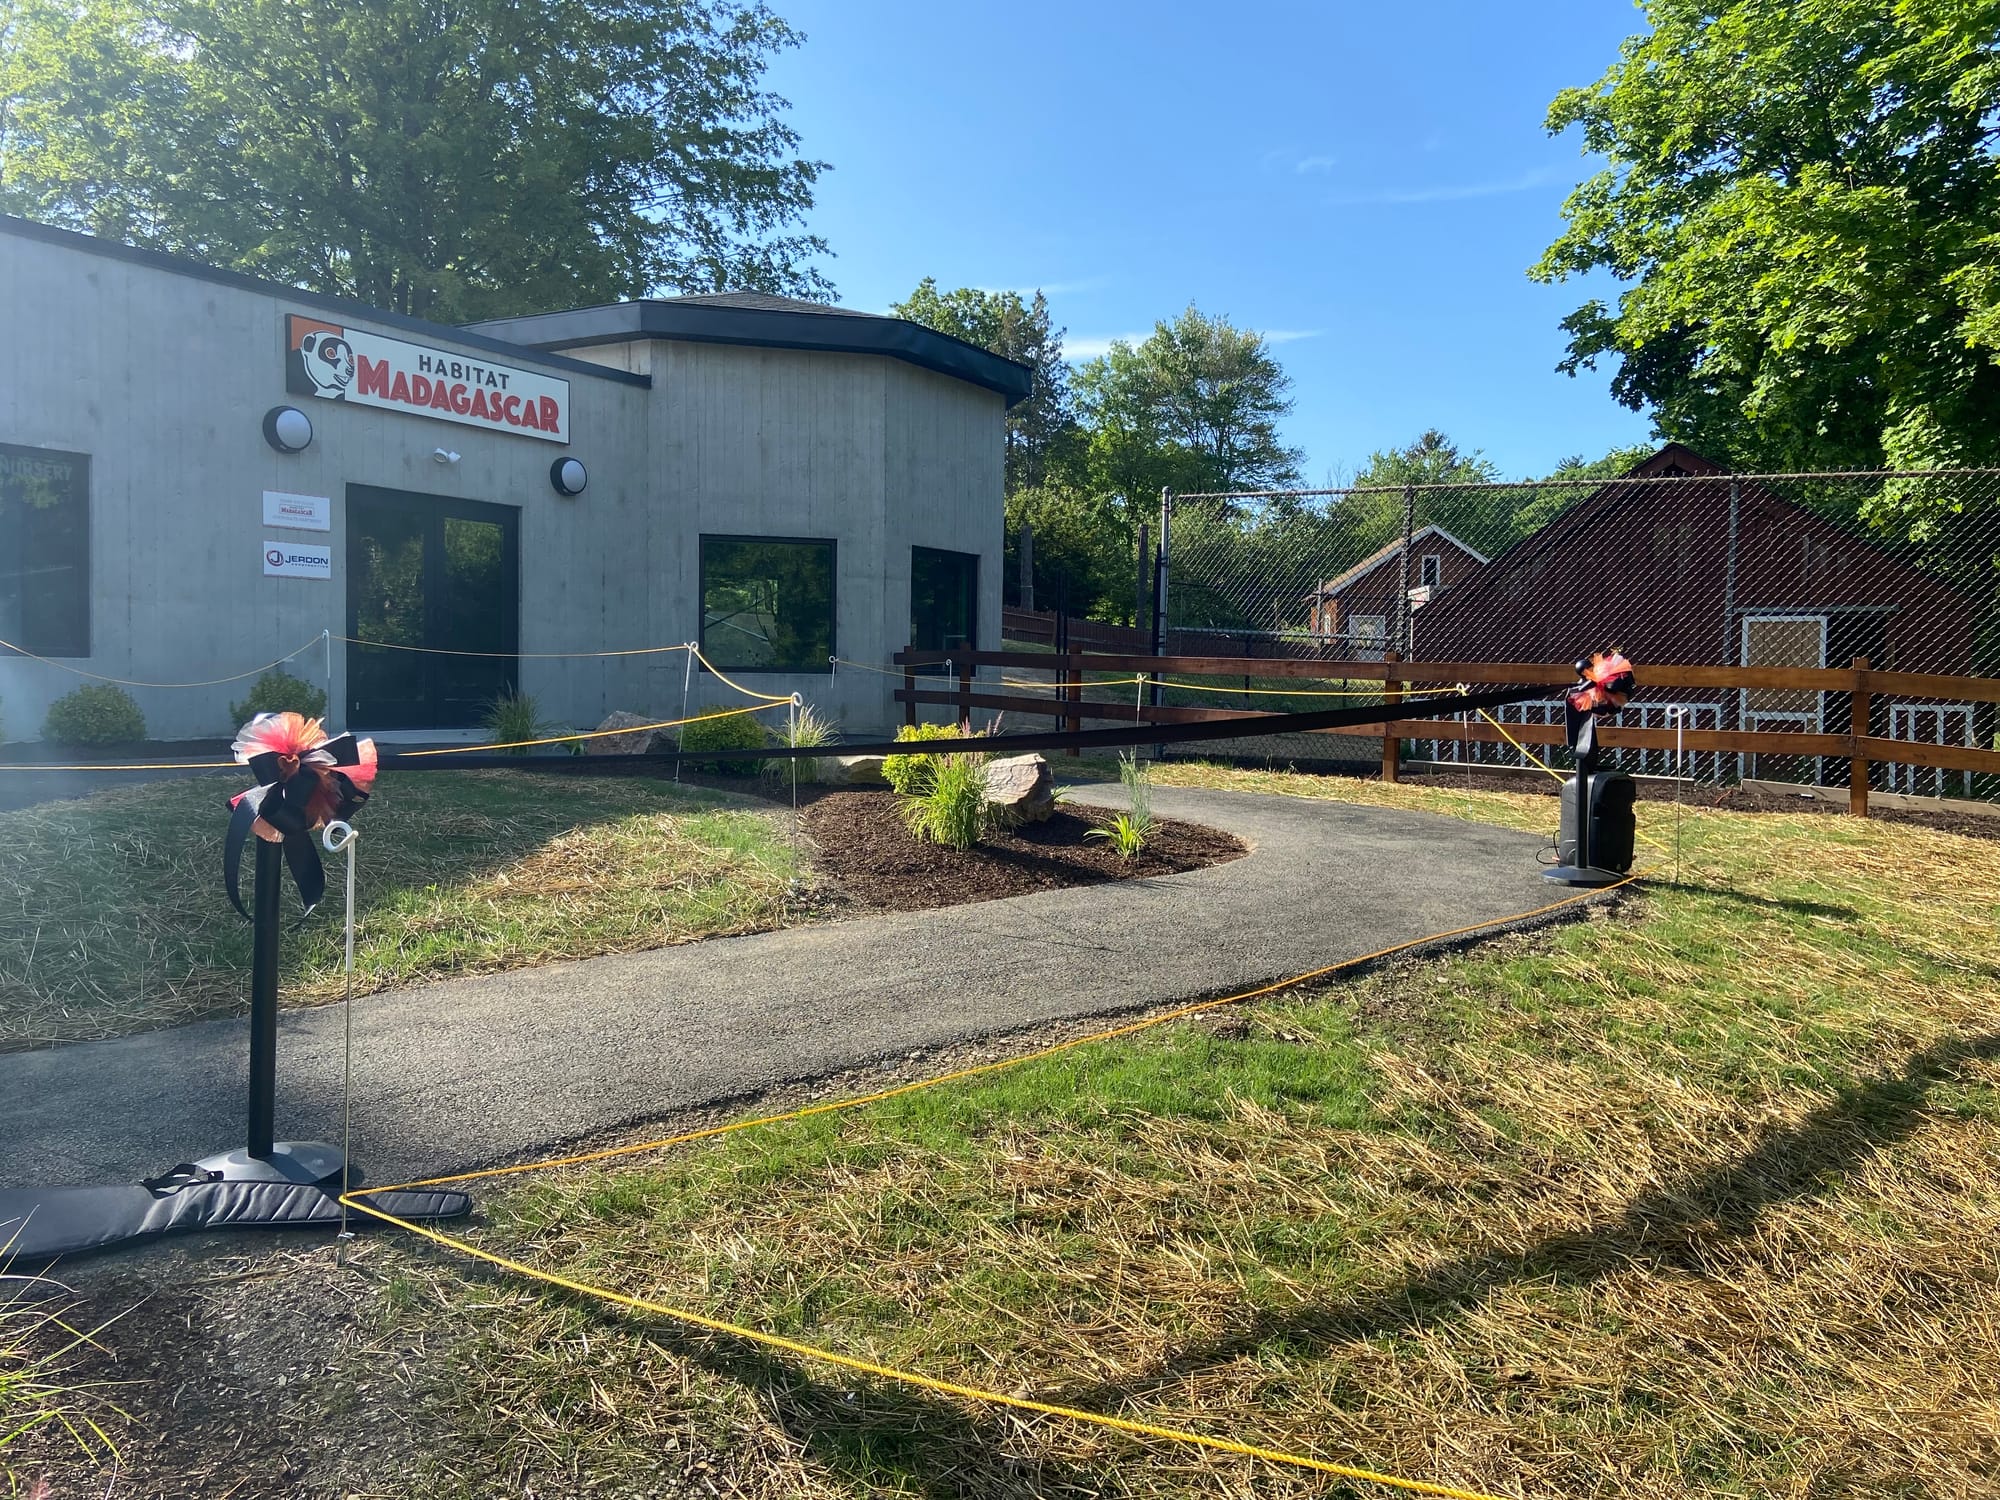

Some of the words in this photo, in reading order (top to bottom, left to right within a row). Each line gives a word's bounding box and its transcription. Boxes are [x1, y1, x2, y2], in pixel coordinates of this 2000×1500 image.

[418, 354, 510, 390] HABITAT
[356, 354, 561, 434] MADAGASCAR
[285, 555, 328, 565] JERDON
